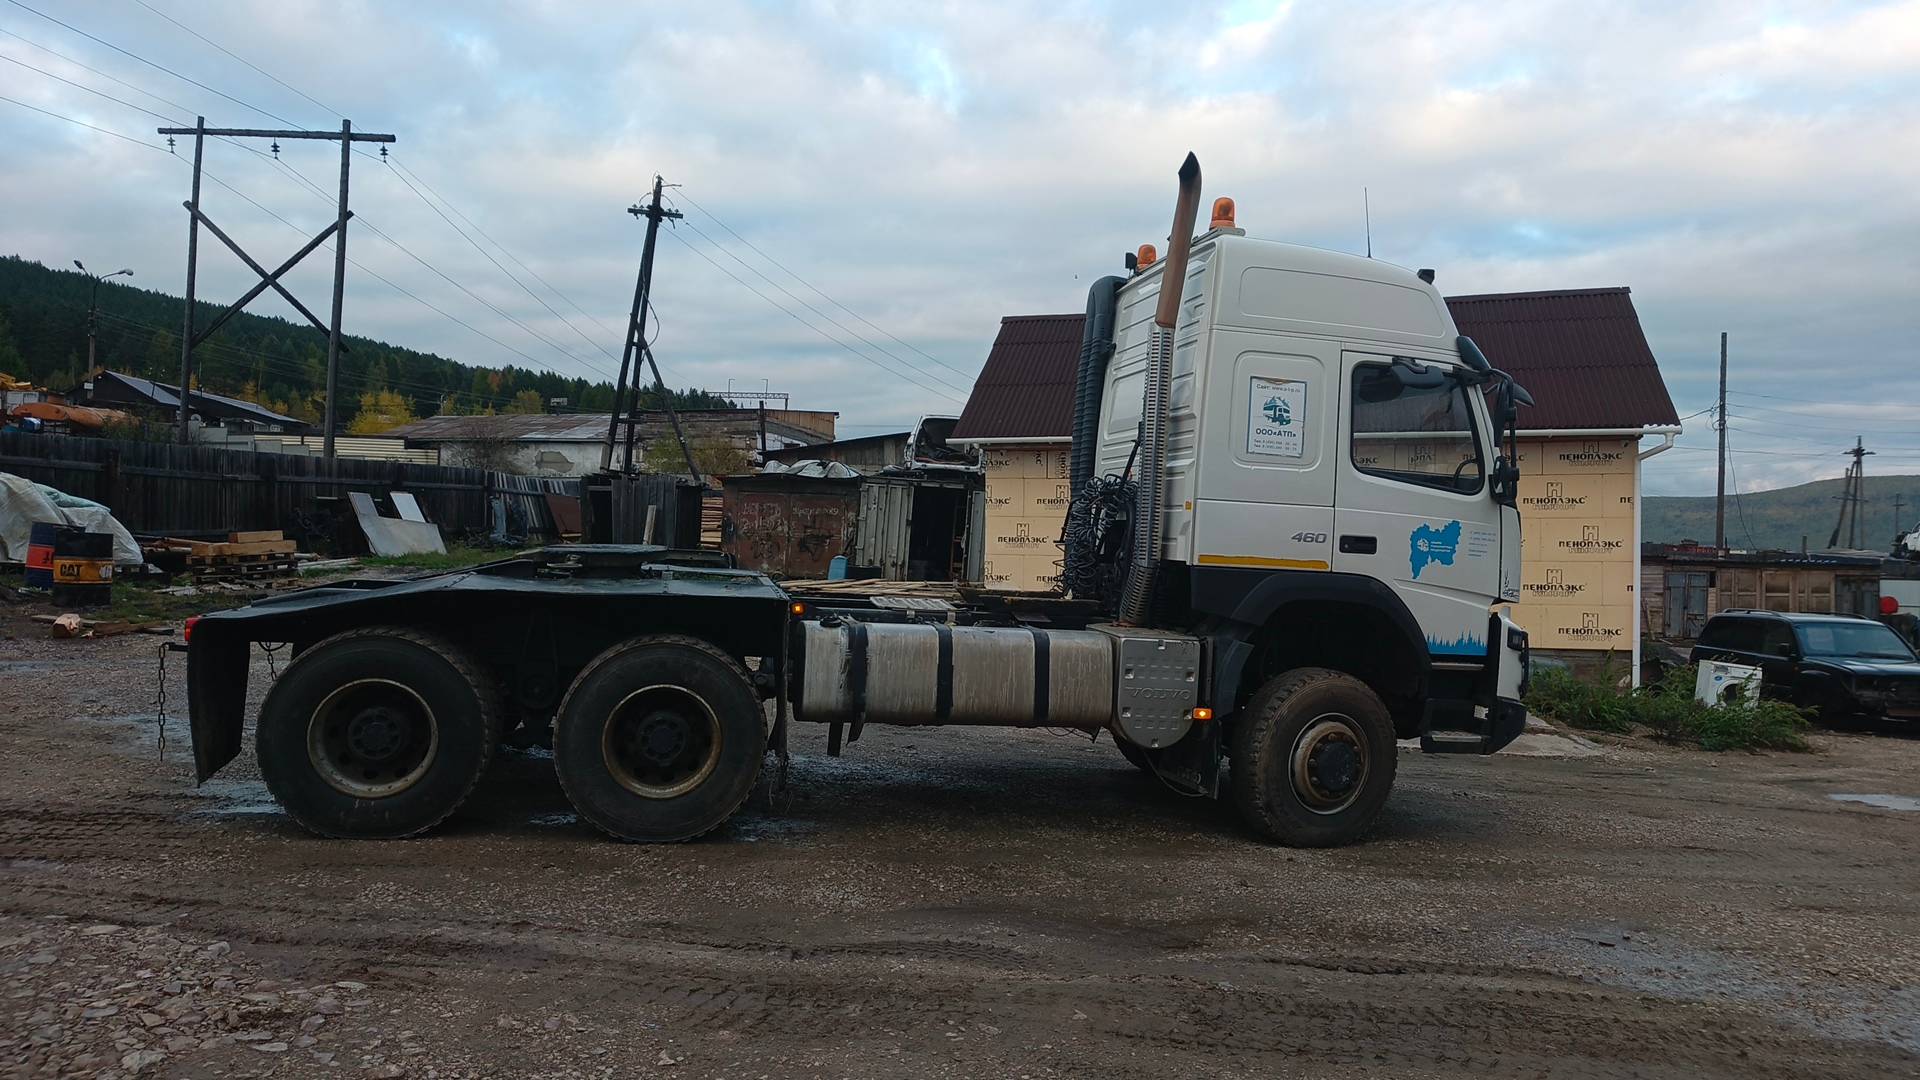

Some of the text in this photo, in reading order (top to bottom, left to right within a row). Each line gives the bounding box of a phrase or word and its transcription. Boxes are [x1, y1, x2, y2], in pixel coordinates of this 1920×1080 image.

[1559, 453, 1623, 461] ПЕНОПЛЭКС
[1522, 497, 1586, 505] ПЕНОПЛЭКС
[997, 536, 1048, 544] ПЕНОПЛЭКС
[1291, 531, 1328, 543] 460
[1558, 540, 1623, 548] ПЕНОПЛЭКС
[61, 563, 82, 577] CAT
[1522, 583, 1586, 592] ПЕНОПЛЭКС
[1558, 627, 1622, 636] ПЕНОПЛЭКС
